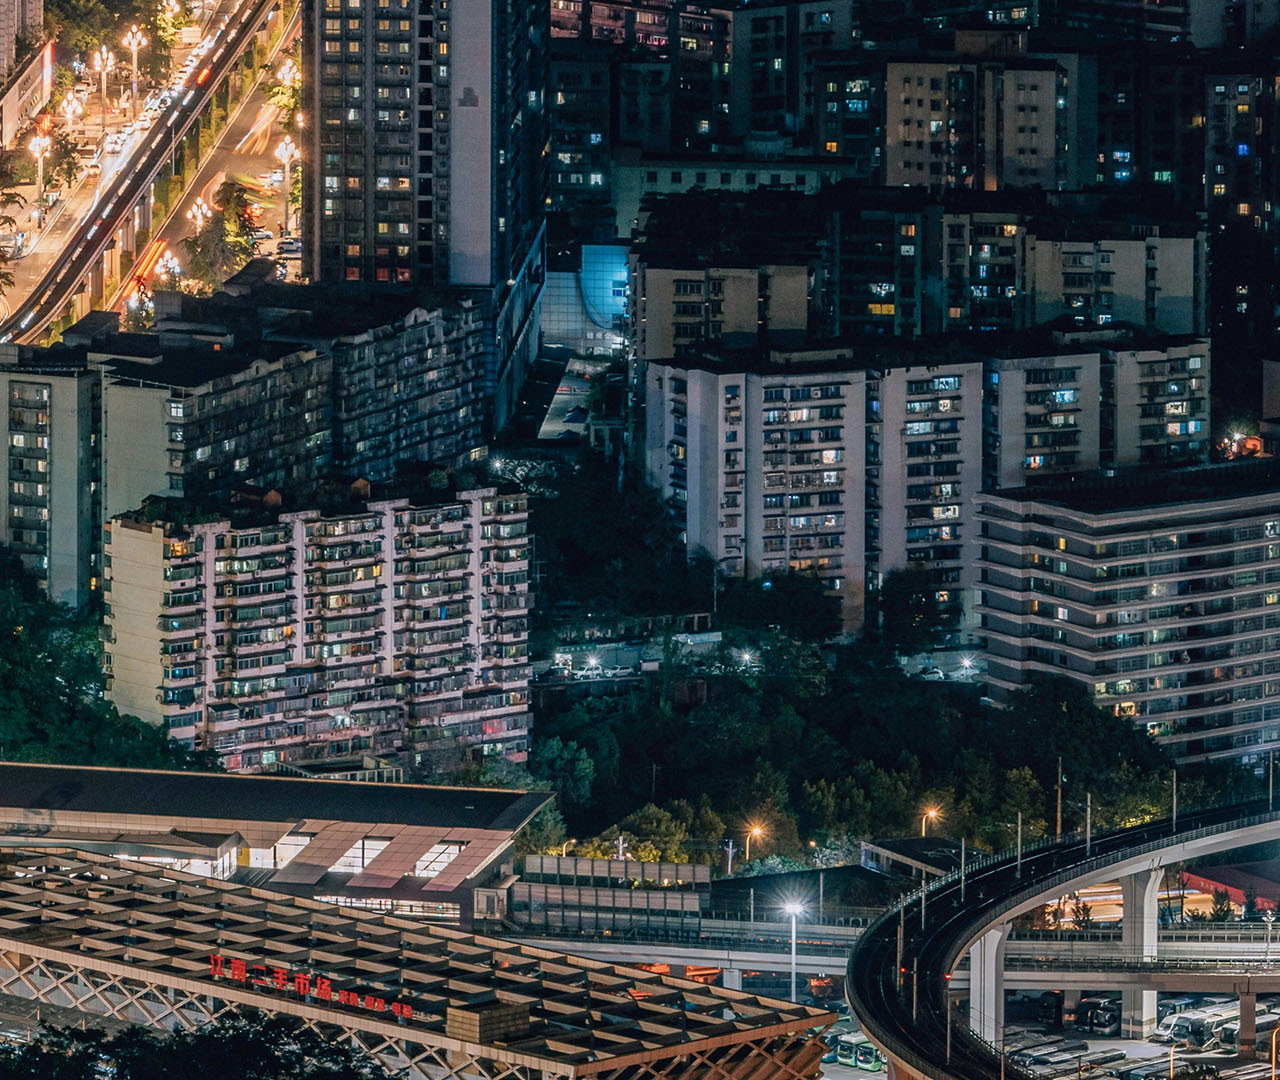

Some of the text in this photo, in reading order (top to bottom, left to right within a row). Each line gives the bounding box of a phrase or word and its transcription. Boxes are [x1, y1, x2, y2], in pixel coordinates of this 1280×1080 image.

[209, 953, 332, 1001] 江南二手市场
